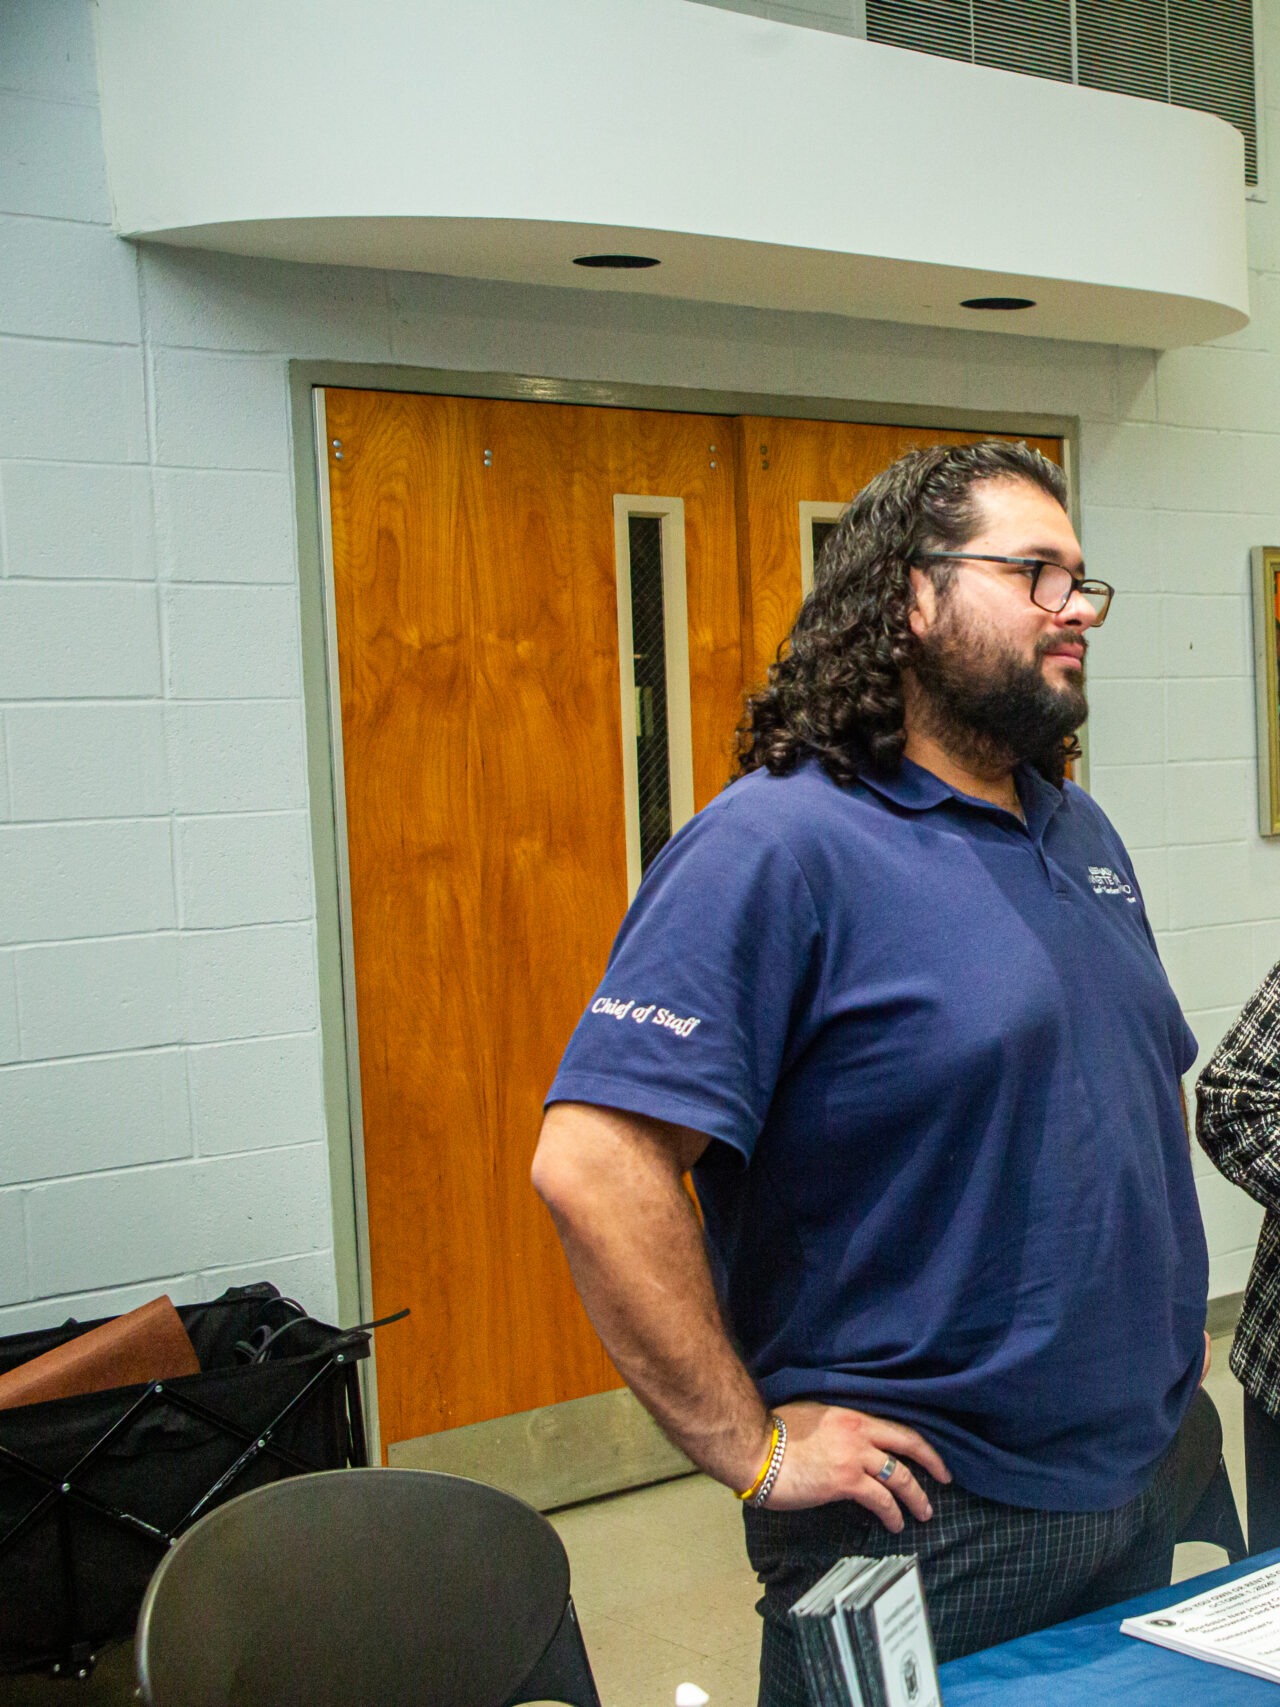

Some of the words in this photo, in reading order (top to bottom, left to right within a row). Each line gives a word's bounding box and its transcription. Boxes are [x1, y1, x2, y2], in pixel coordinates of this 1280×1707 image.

[591, 997, 635, 1020] Chief
[632, 1004, 656, 1024] of
[652, 1007, 701, 1038] Staff
